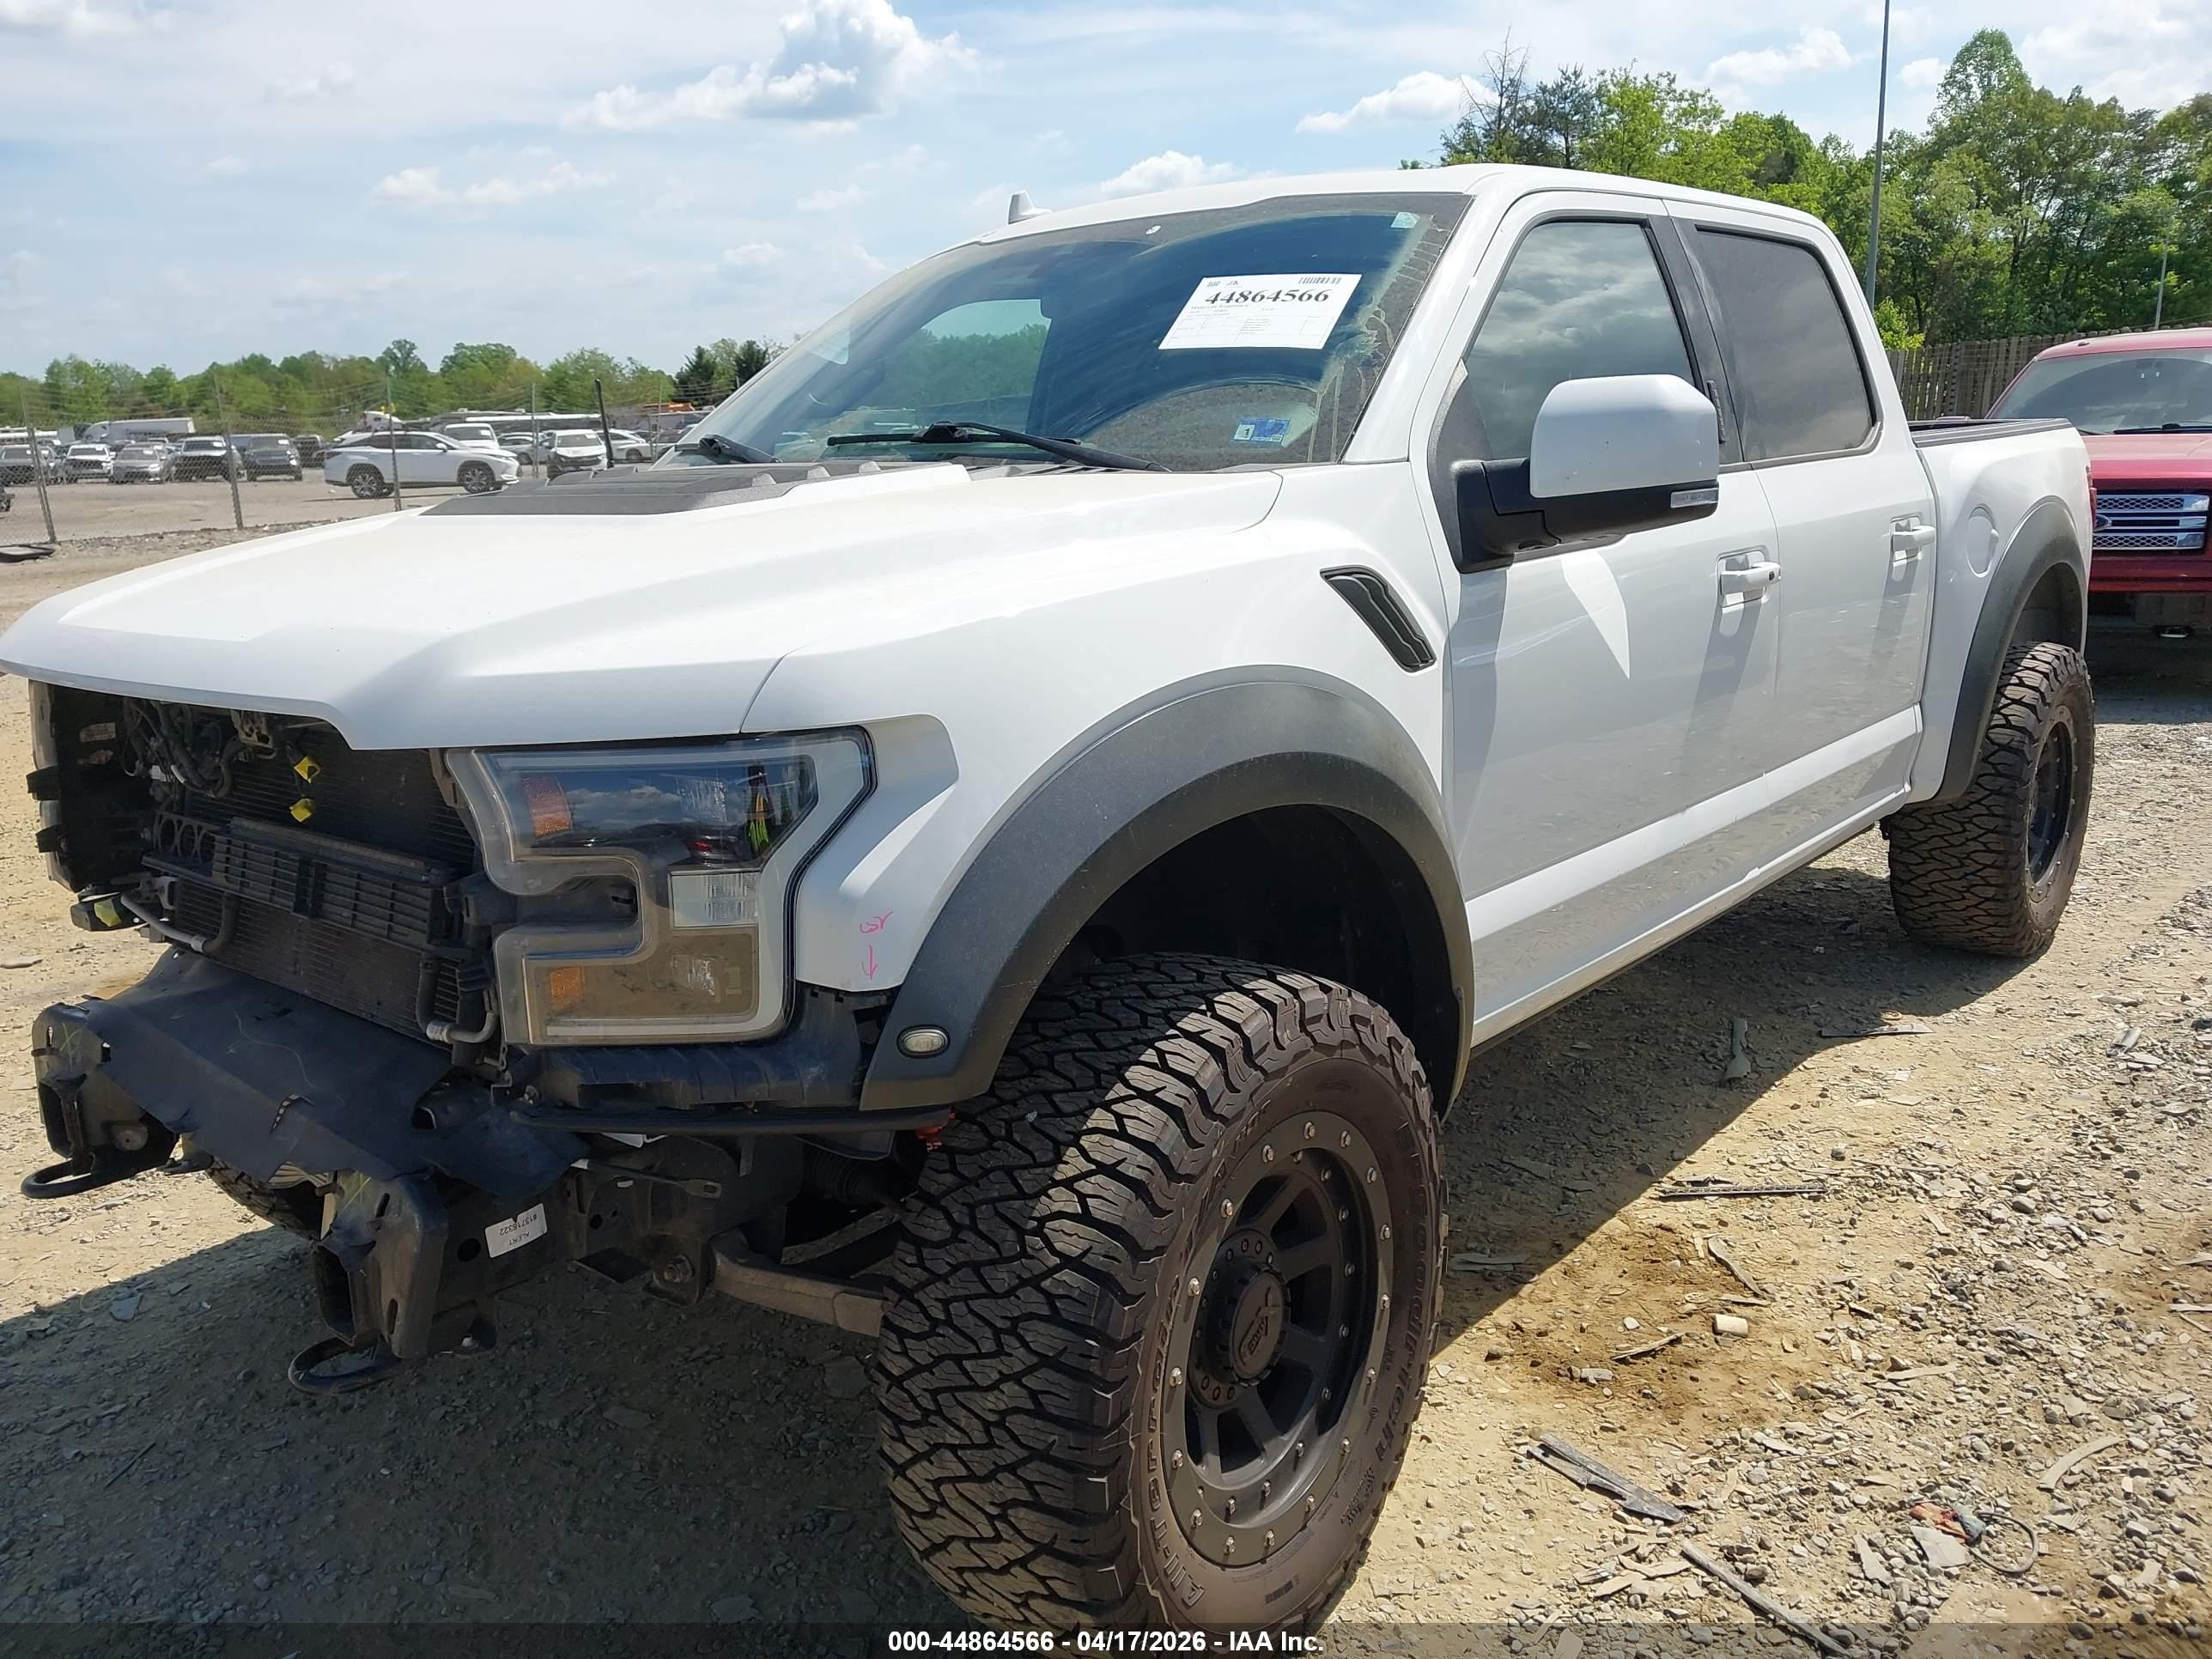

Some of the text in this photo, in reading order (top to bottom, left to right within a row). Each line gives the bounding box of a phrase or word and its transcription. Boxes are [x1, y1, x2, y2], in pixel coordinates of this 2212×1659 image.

[1205, 289, 1330, 304] 44864566
[500, 1214, 537, 1235] #13716322
[509, 1231, 530, 1244] ALERT
